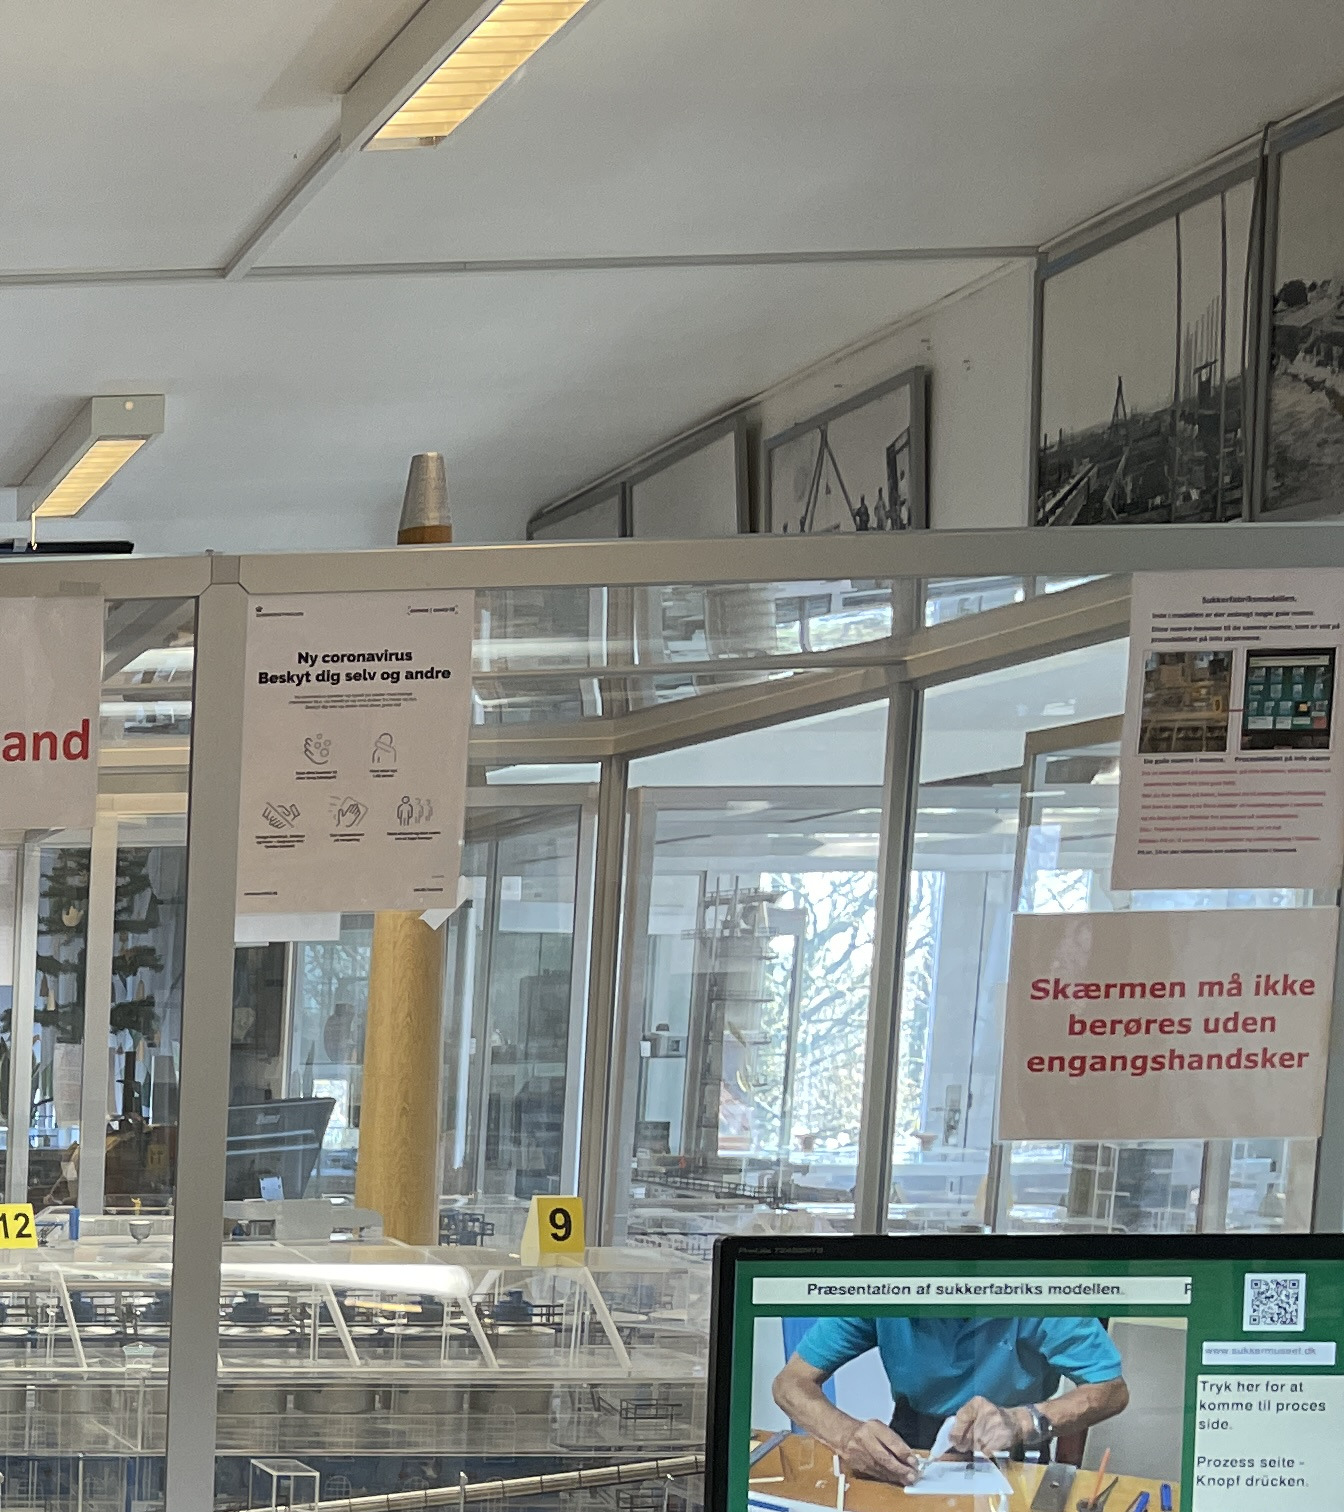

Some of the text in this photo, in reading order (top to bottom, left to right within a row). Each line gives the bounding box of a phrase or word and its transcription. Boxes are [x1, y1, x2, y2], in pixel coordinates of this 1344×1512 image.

[298, 649, 413, 666] Ny coronavirus
[258, 668, 451, 686] Beskyt dig selv og andre
[1030, 973, 1315, 1000] Skærmen må ikke
[1068, 1011, 1276, 1038] berøres uden
[1027, 1047, 1310, 1077] engangshandsker
[549, 1210, 572, 1242] 9
[807, 1282, 911, 1297] Præsentation
[916, 1282, 930, 1296] af
[935, 1281, 1043, 1297] sukkerfabriks
[1048, 1282, 1125, 1296] modellen.
[1200, 1381, 1303, 1394] Tryk her for at
[1199, 1400, 1326, 1414] komme til proces
[1197, 1456, 1255, 1468] Prozess
[1261, 1456, 1295, 1468] seite
[1196, 1476, 1240, 1489] Knopf
